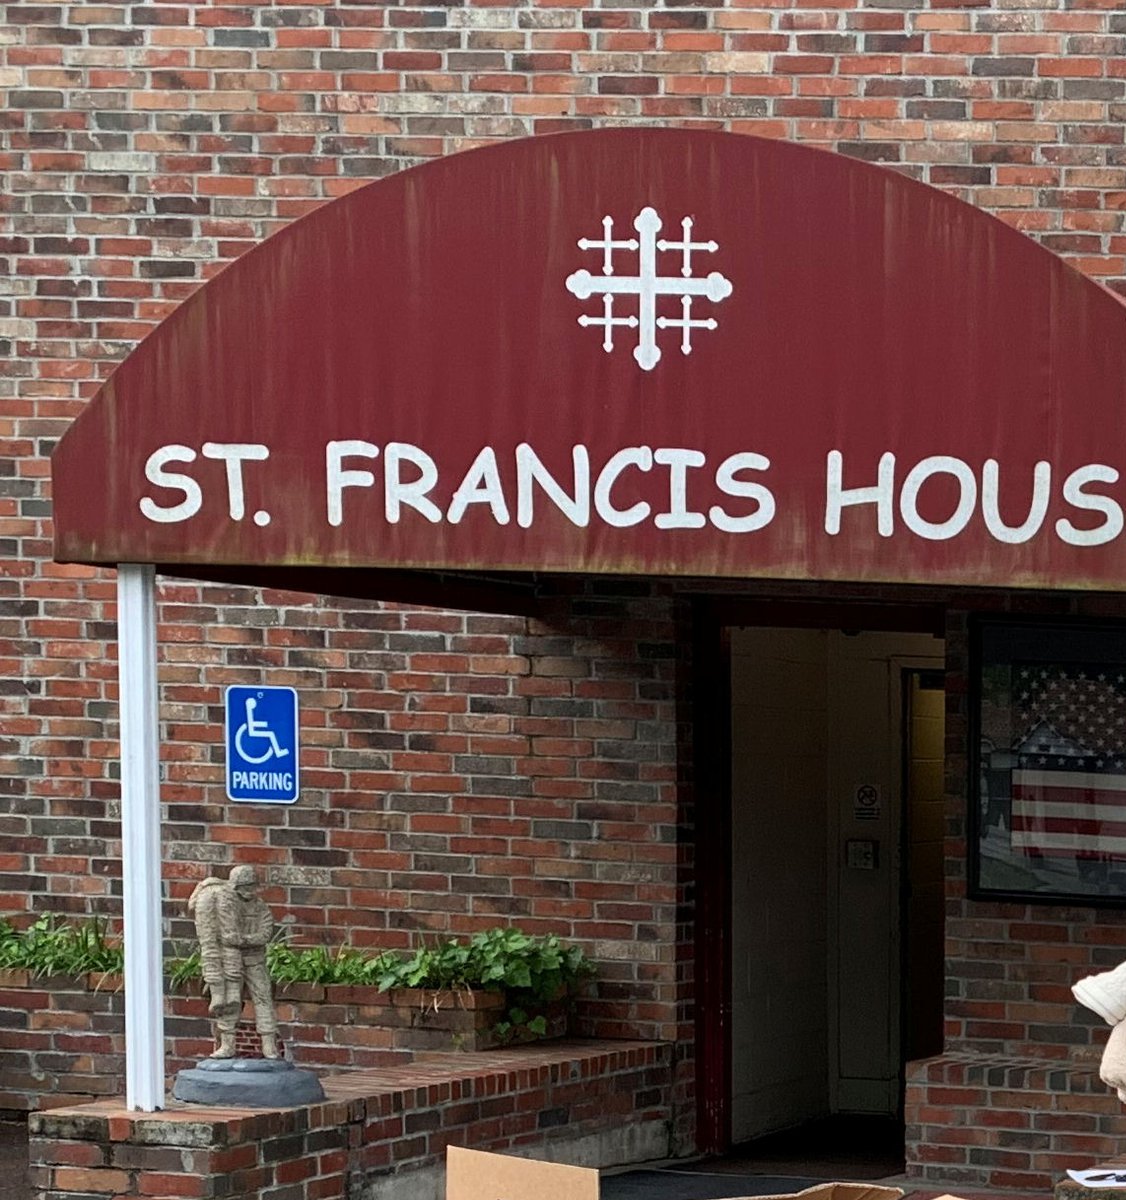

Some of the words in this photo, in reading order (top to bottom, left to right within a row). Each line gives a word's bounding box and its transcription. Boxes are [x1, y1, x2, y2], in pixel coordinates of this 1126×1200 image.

[139, 441, 271, 527] ST.
[325, 439, 776, 534] FRANCIS
[232, 770, 293, 792] PARKING
